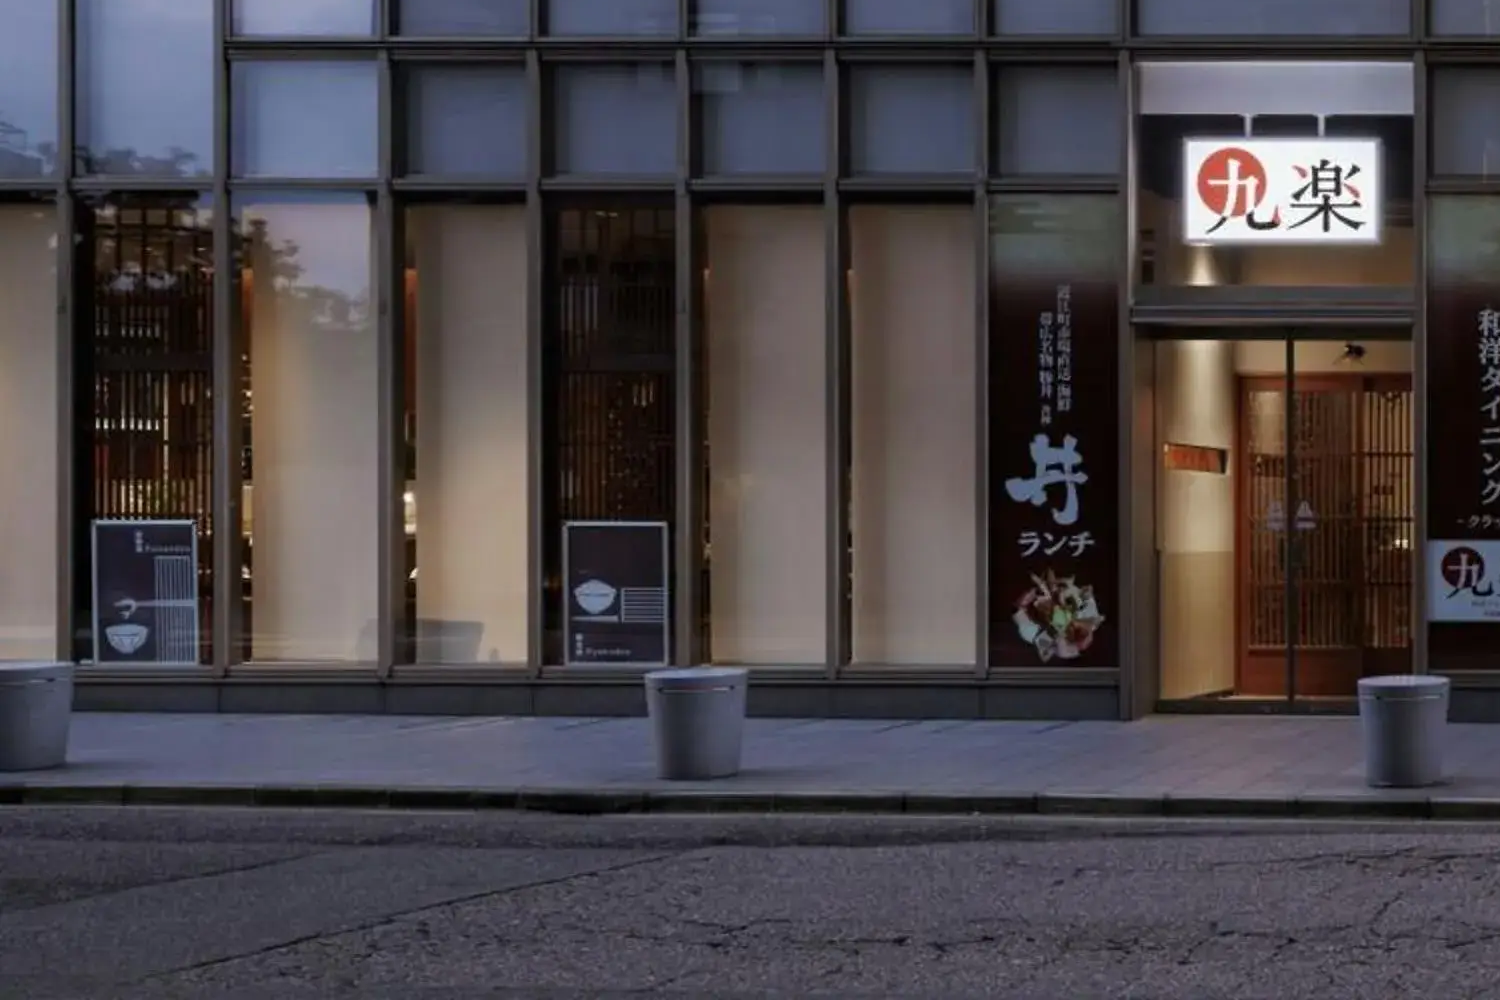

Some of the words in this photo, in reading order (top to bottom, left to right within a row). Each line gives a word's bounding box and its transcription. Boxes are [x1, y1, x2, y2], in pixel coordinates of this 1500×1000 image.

[1203, 156, 1366, 234] 九楽
[1017, 531, 1095, 557] ランチ
